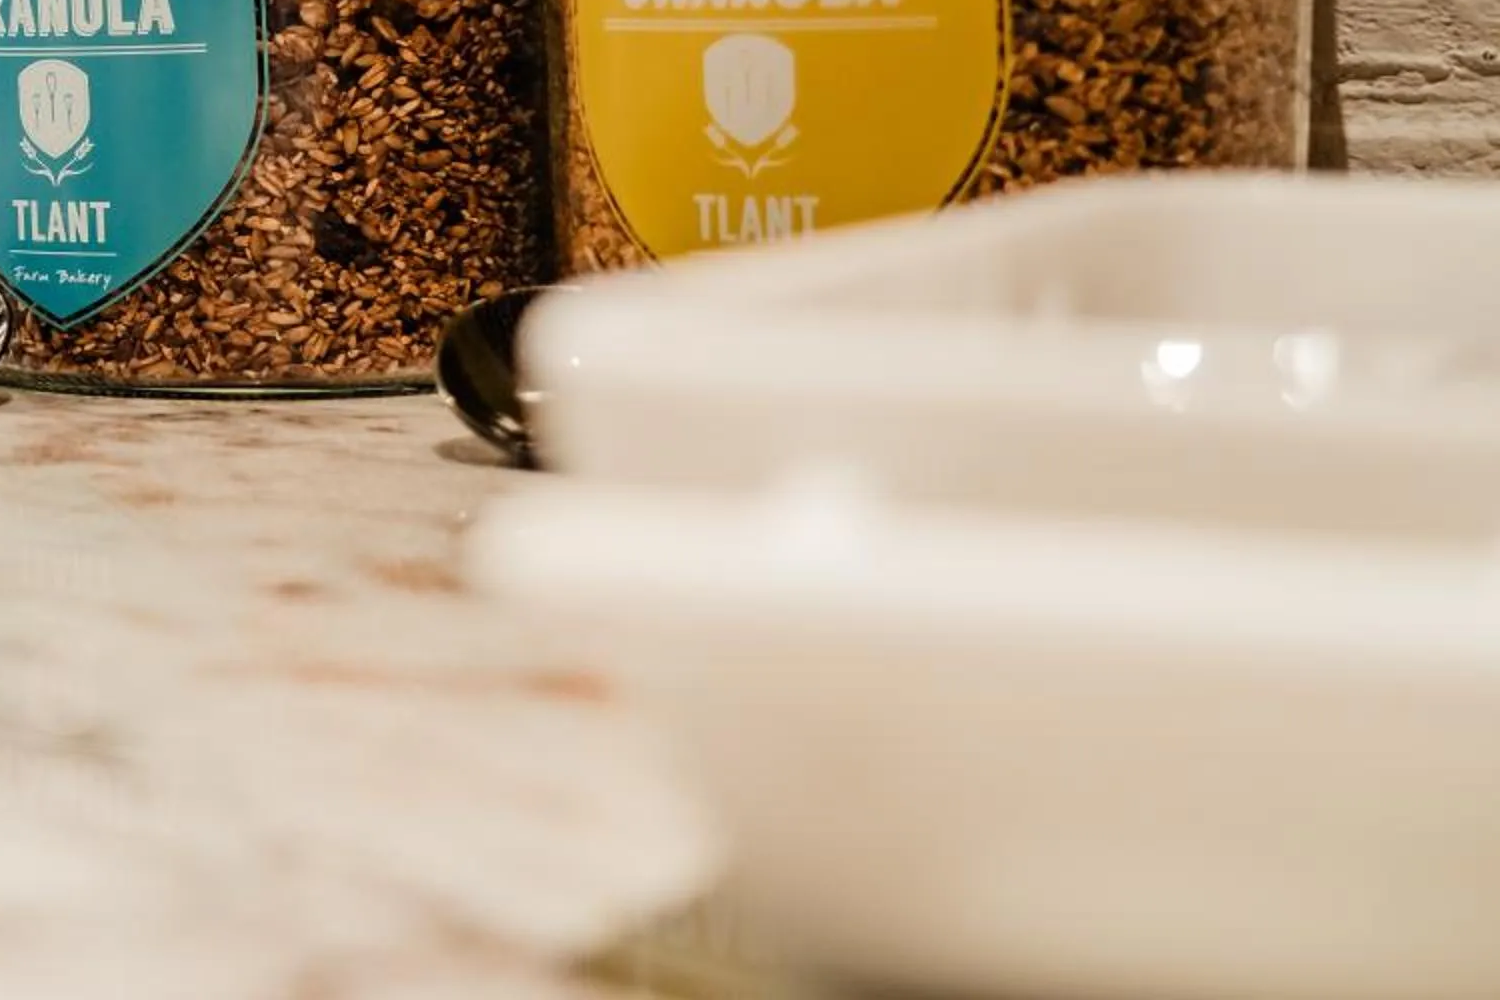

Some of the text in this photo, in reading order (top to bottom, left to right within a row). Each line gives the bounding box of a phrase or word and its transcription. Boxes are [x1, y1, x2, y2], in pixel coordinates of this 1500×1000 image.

[11, 199, 112, 243] TLANT
[12, 265, 112, 291] Farm Bakery
